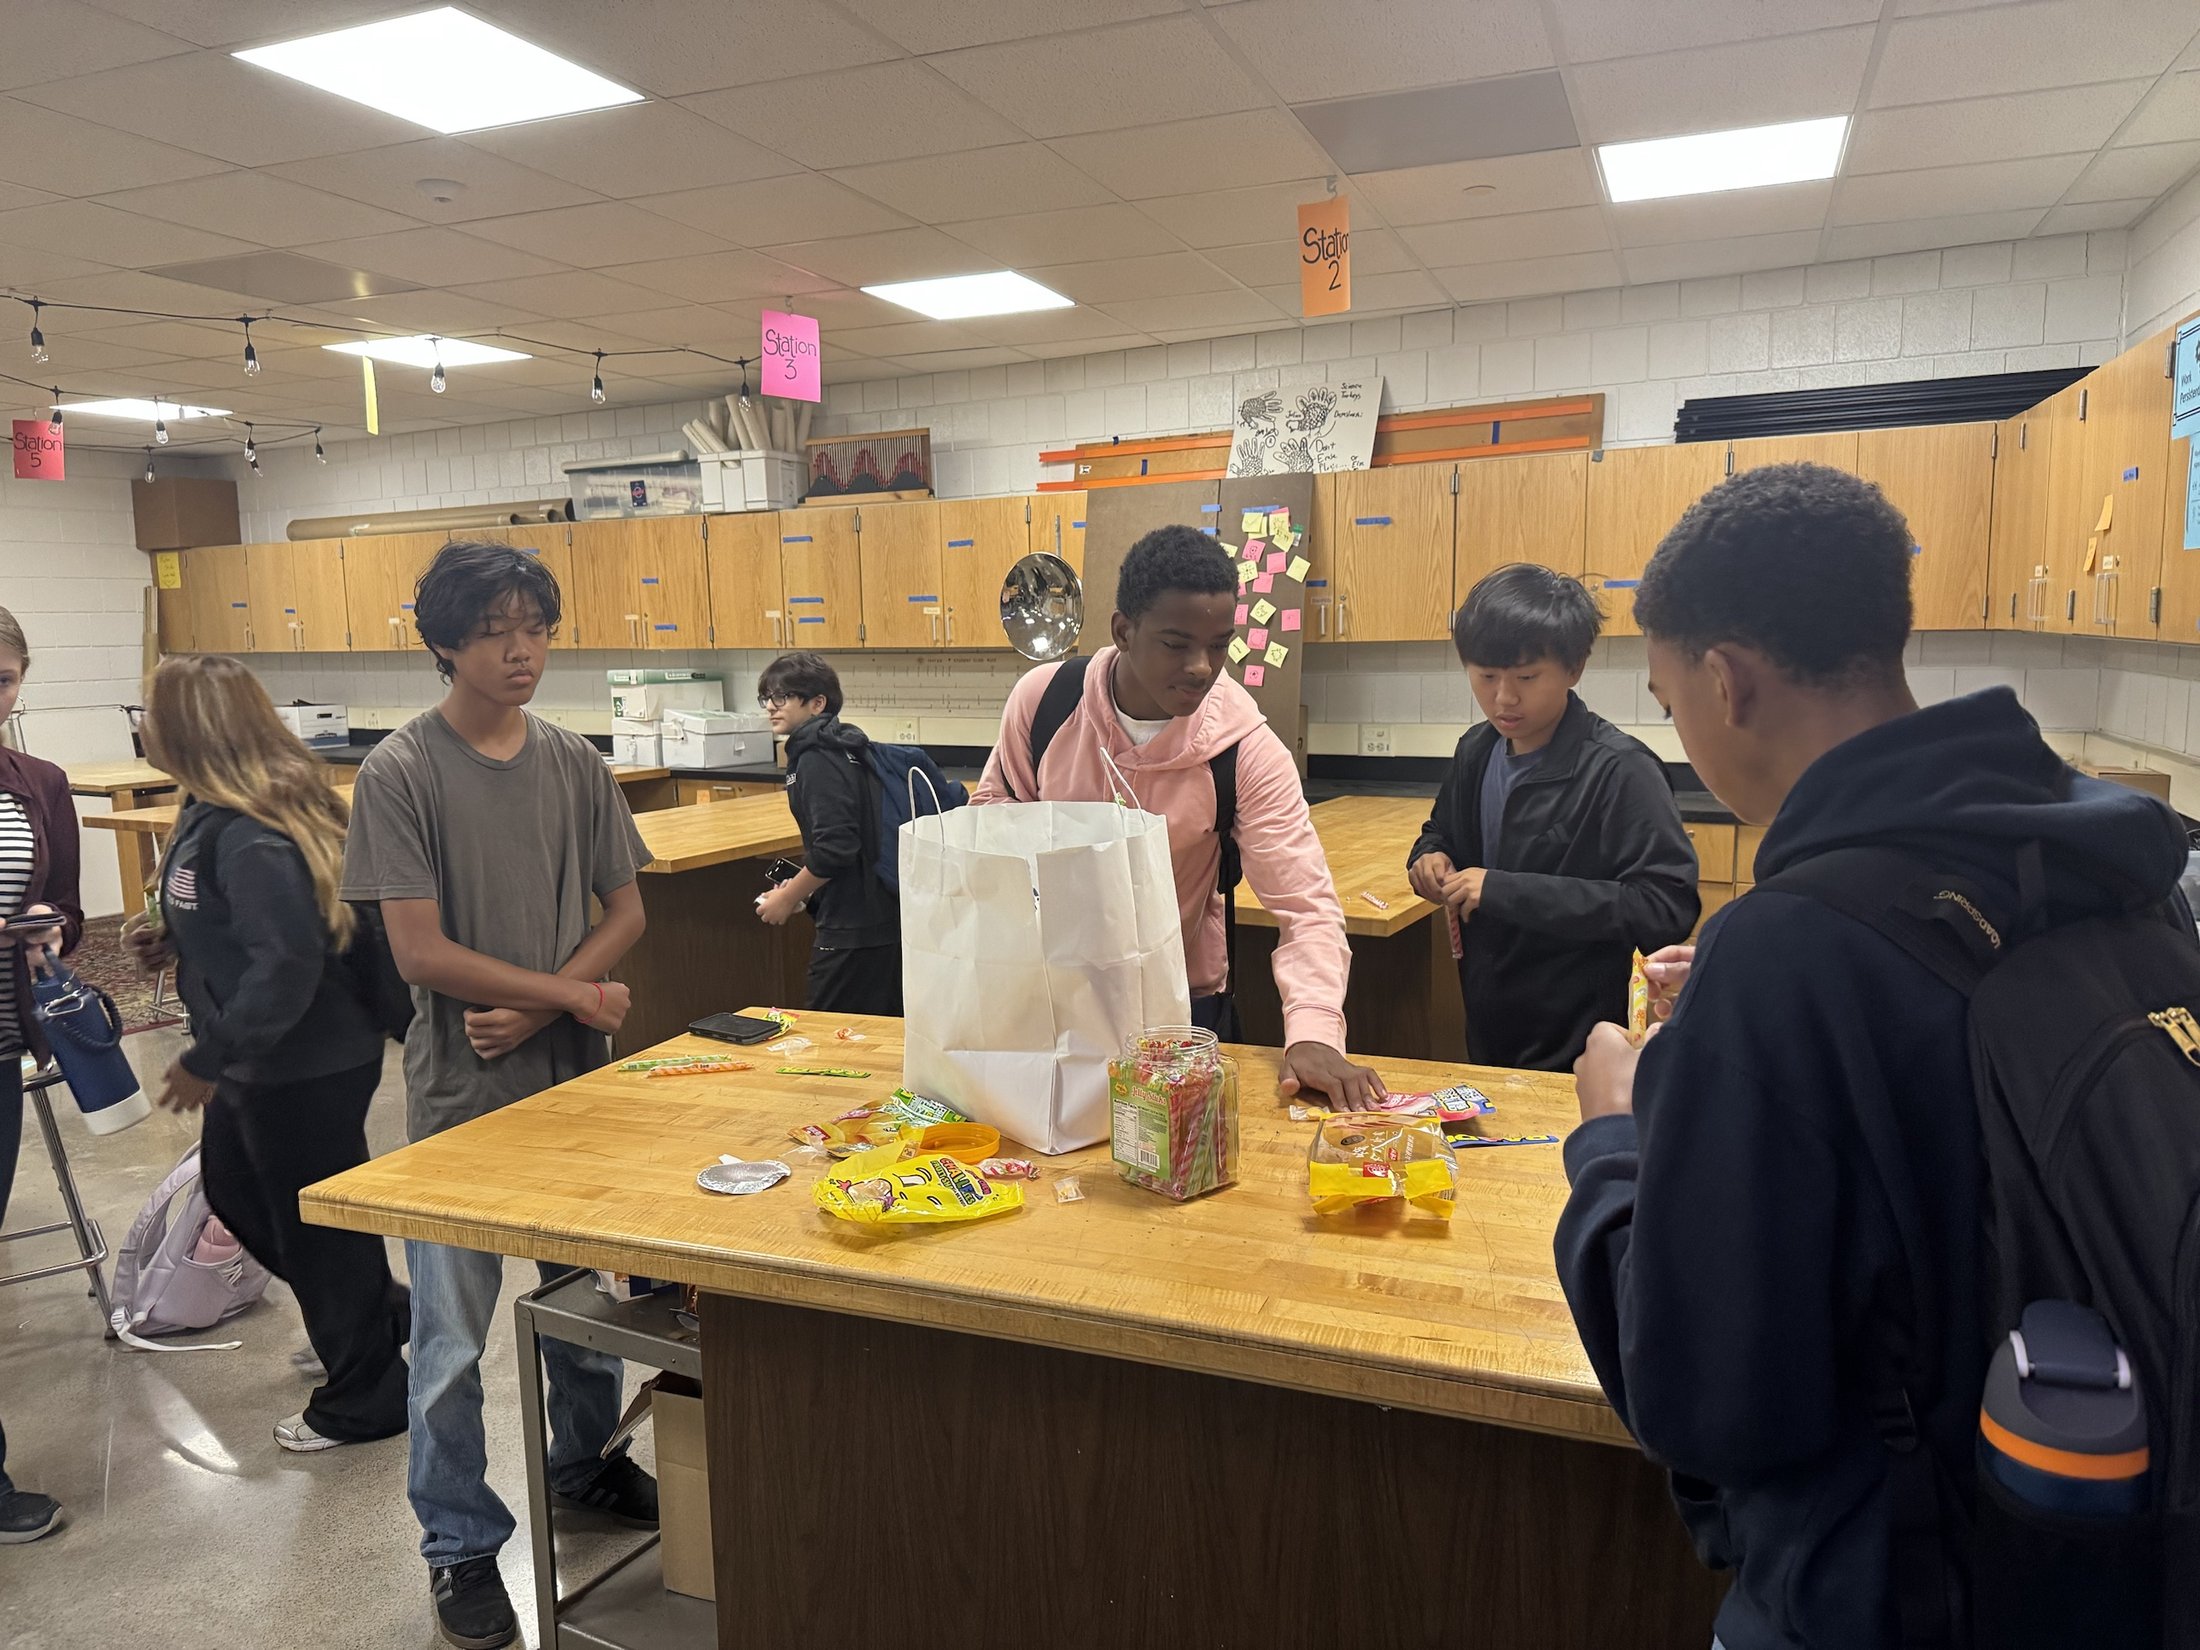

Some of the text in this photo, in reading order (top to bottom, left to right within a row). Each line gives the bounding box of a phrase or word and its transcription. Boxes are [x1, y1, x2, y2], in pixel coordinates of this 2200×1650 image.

[1302, 227, 1349, 264] Statio
[1328, 260, 1341, 291] 2
[763, 328, 817, 358] Station
[784, 358, 798, 380] 3
[14, 431, 62, 453] Station
[30, 452, 42, 468] 5
[1131, 1085, 1149, 1101] Jelly
